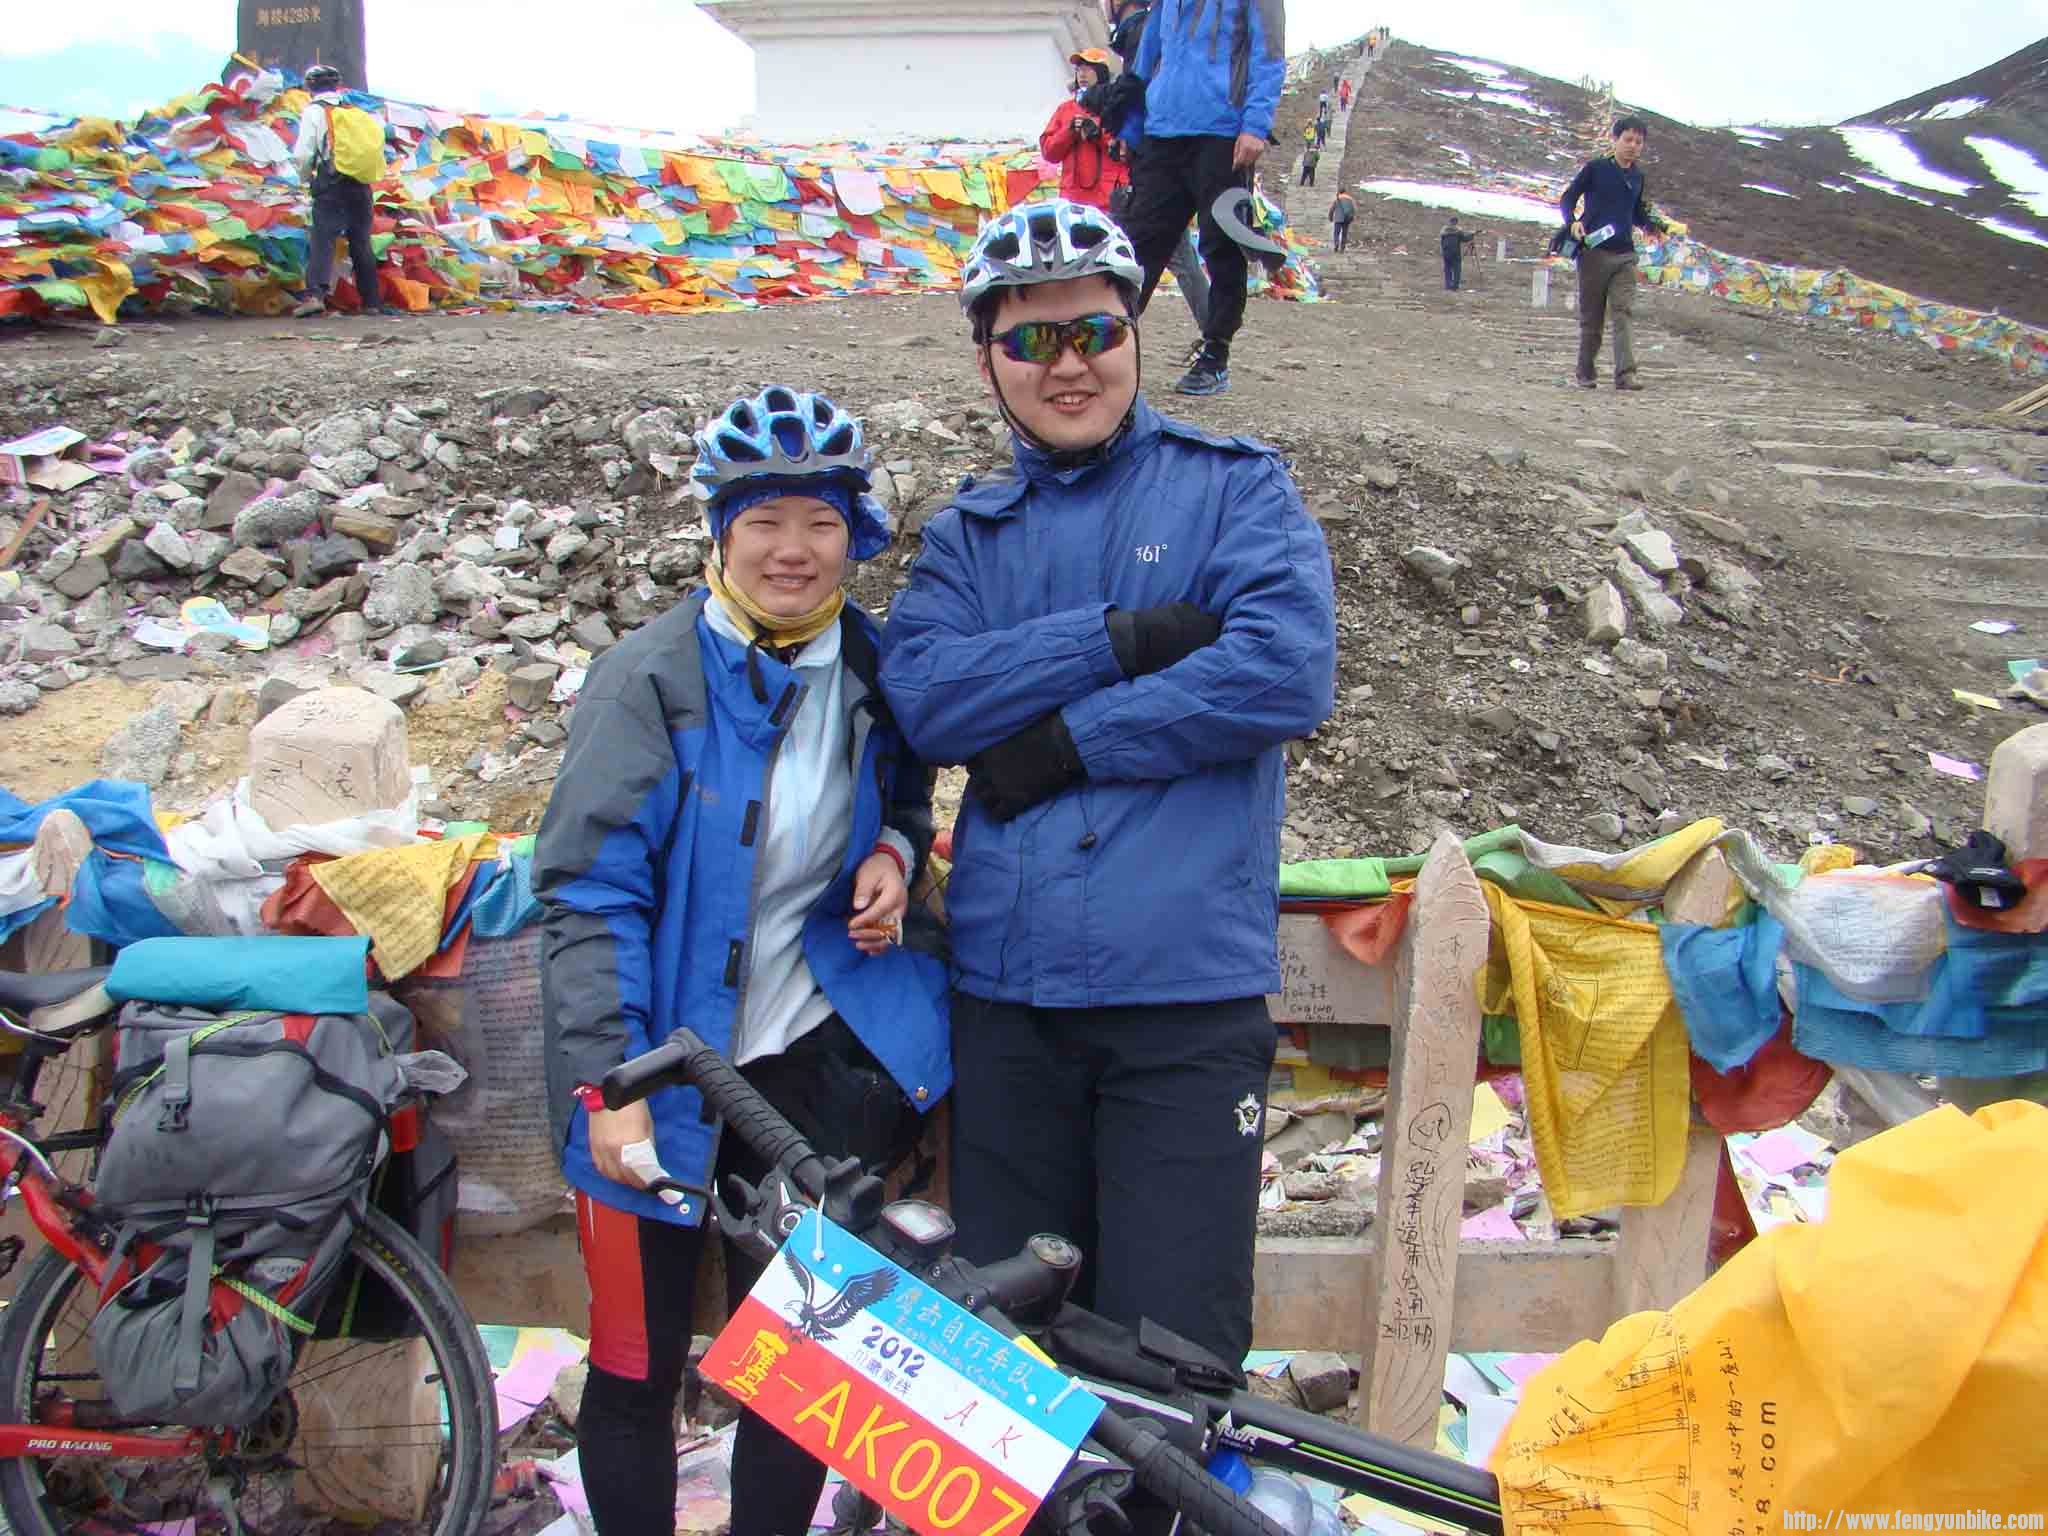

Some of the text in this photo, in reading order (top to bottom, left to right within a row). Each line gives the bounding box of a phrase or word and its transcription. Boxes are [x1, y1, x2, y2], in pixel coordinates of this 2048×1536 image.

[862, 1325, 925, 1378] 2012
[27, 1438, 113, 1451] PRO RACING
[992, 1425, 1024, 1459] K
